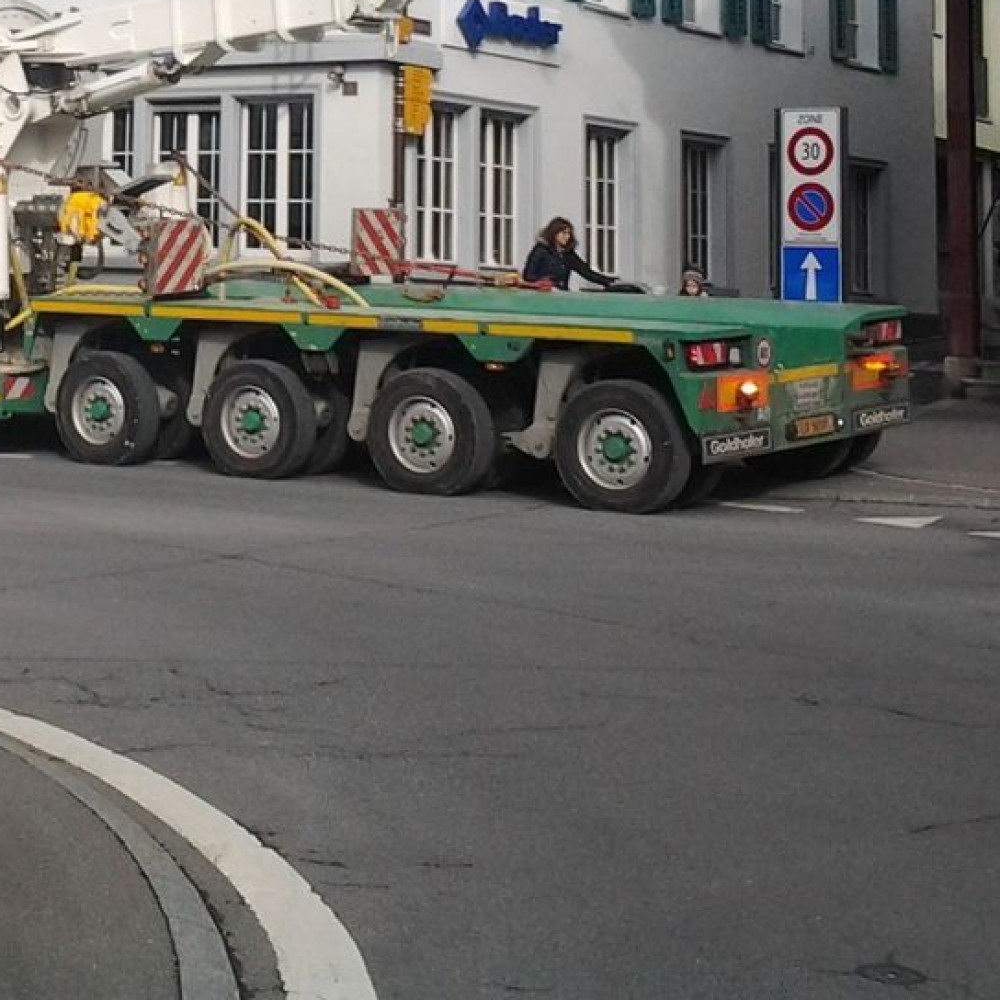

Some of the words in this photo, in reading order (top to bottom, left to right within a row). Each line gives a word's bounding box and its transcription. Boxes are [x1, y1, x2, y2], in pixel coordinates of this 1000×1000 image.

[797, 114, 823, 124] ZONE
[801, 142, 820, 160] 30
[710, 433, 764, 455] Goldhofer
